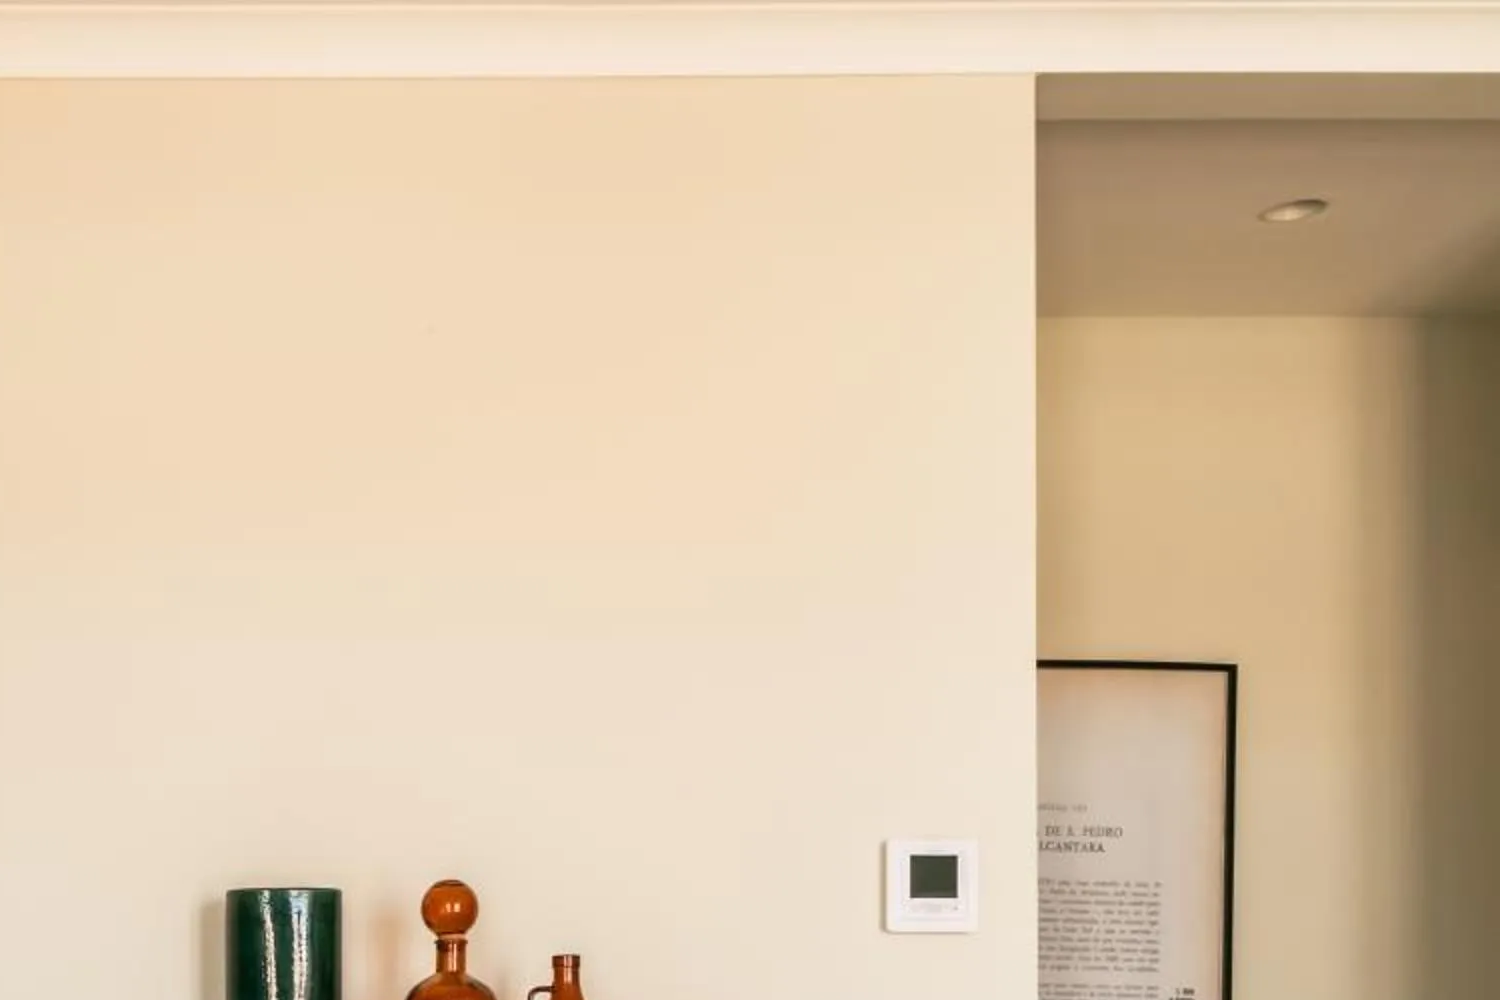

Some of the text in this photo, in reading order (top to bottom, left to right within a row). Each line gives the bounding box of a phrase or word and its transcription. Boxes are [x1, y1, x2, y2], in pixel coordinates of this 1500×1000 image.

[1044, 825, 1061, 837] DE
[1082, 825, 1124, 839] PEDRO
[1038, 840, 1106, 853] LCANTARA
